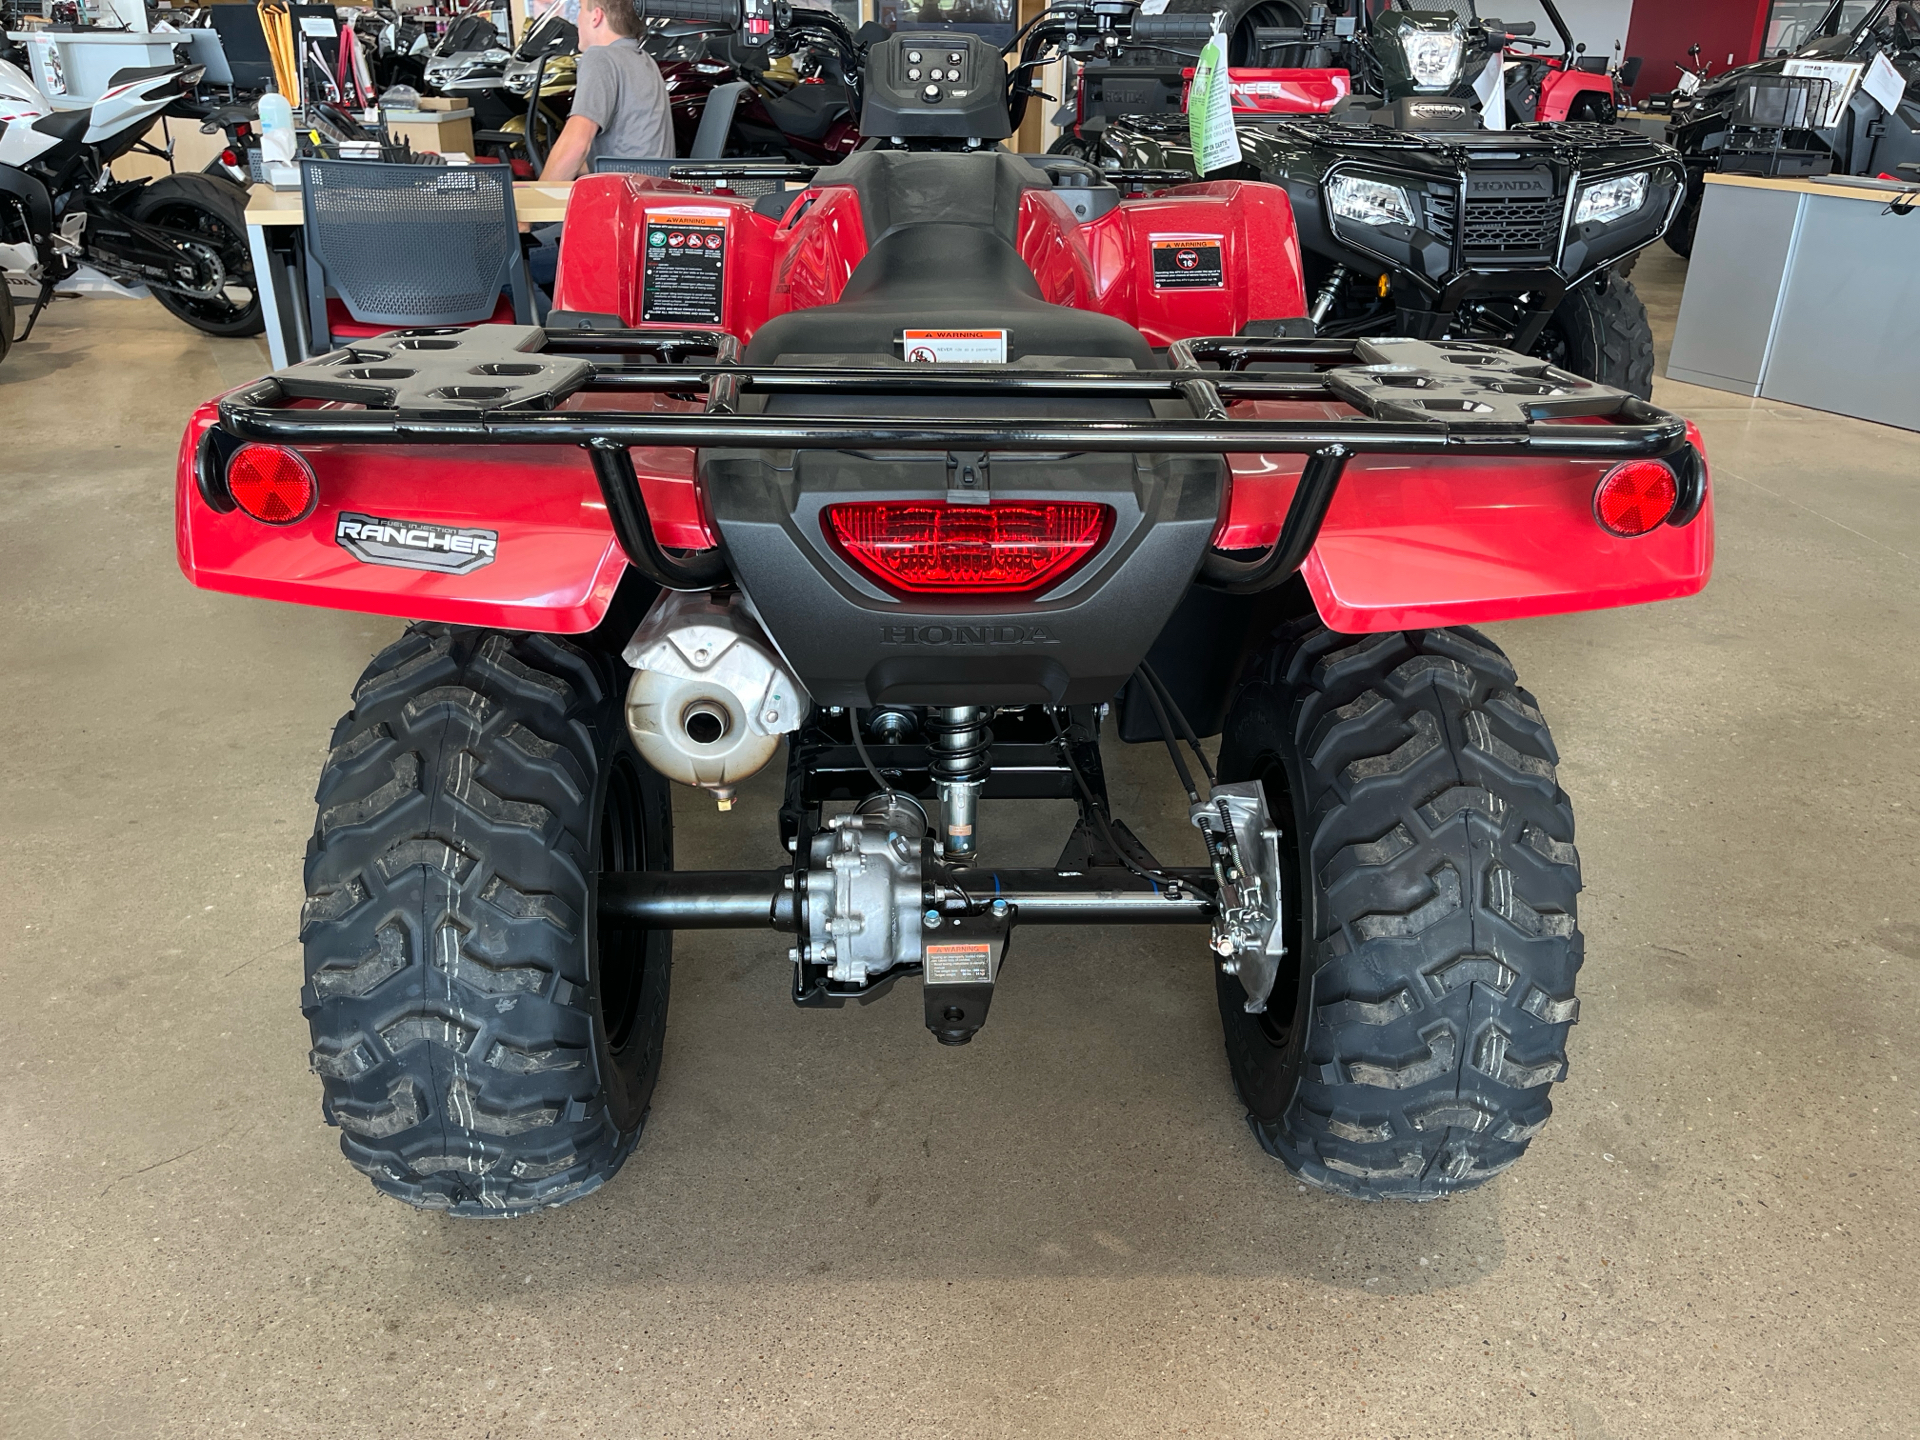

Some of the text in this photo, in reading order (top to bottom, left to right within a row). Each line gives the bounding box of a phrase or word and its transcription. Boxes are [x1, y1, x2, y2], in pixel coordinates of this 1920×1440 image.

[1229, 83, 1281, 94] NEER
[1410, 104, 1466, 116] FOREMAN
[1472, 181, 1546, 192] HONDA
[380, 520, 458, 534] FUEL INJECTION
[337, 521, 497, 556] RANCHER
[880, 625, 1061, 646] HONDA
